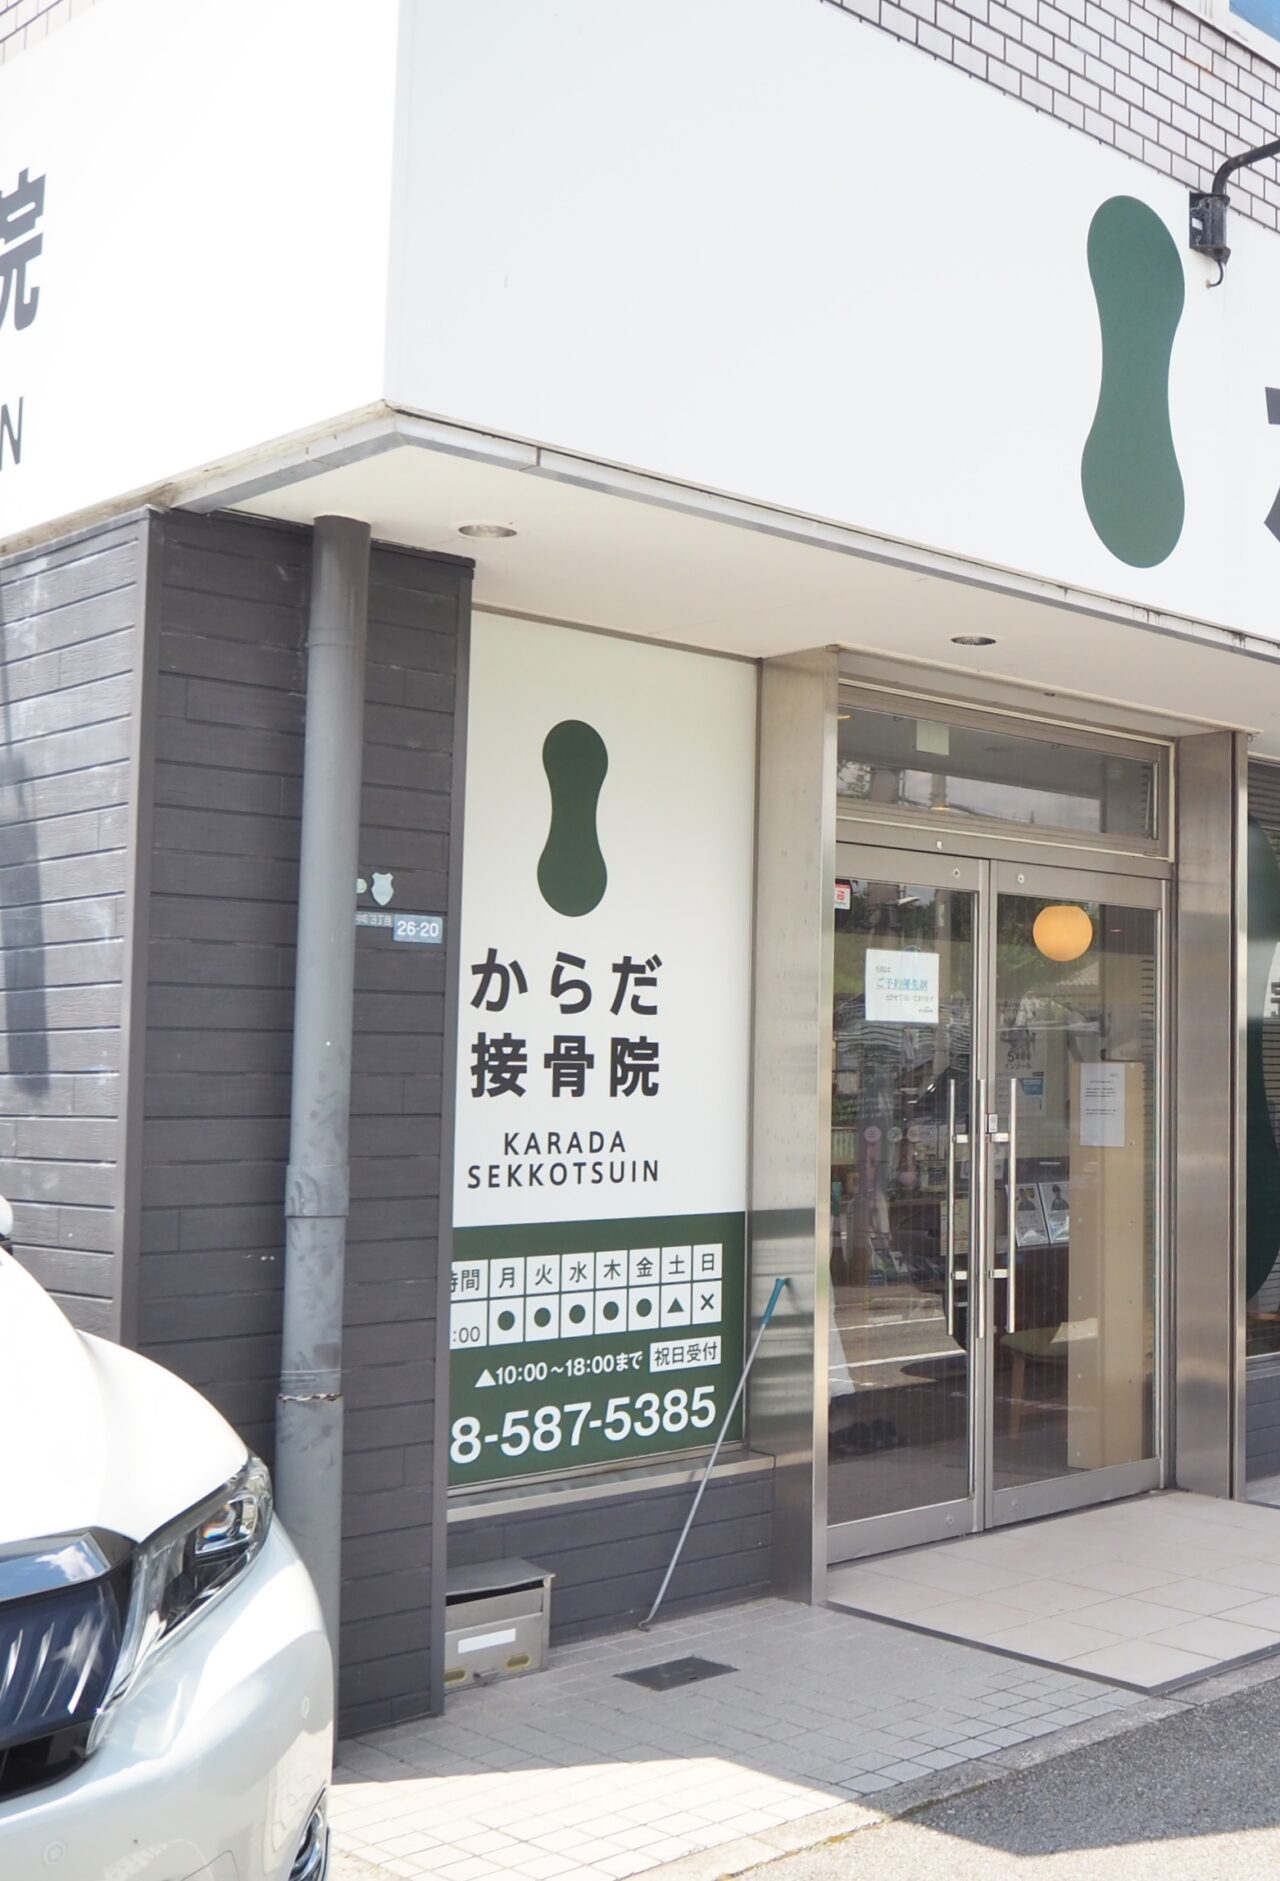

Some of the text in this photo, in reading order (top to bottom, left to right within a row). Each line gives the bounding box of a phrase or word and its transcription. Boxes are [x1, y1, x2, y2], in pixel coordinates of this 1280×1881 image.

[396, 920, 439, 937] 26-20
[470, 948, 662, 1015] からだ
[471, 1032, 659, 1098] 接骨院
[504, 1131, 626, 1156] KARADA
[468, 1160, 659, 1189] SEKKOTSUIN
[498, 1267, 515, 1289] 月
[535, 1264, 552, 1285] 火
[569, 1261, 588, 1283] 水
[603, 1259, 621, 1280] 木
[636, 1256, 654, 1278] 金
[669, 1254, 686, 1275] 土
[701, 1253, 715, 1272] 日
[654, 1344, 717, 1367] 祝日受付
[450, 1385, 717, 1465] 8-587-5385
